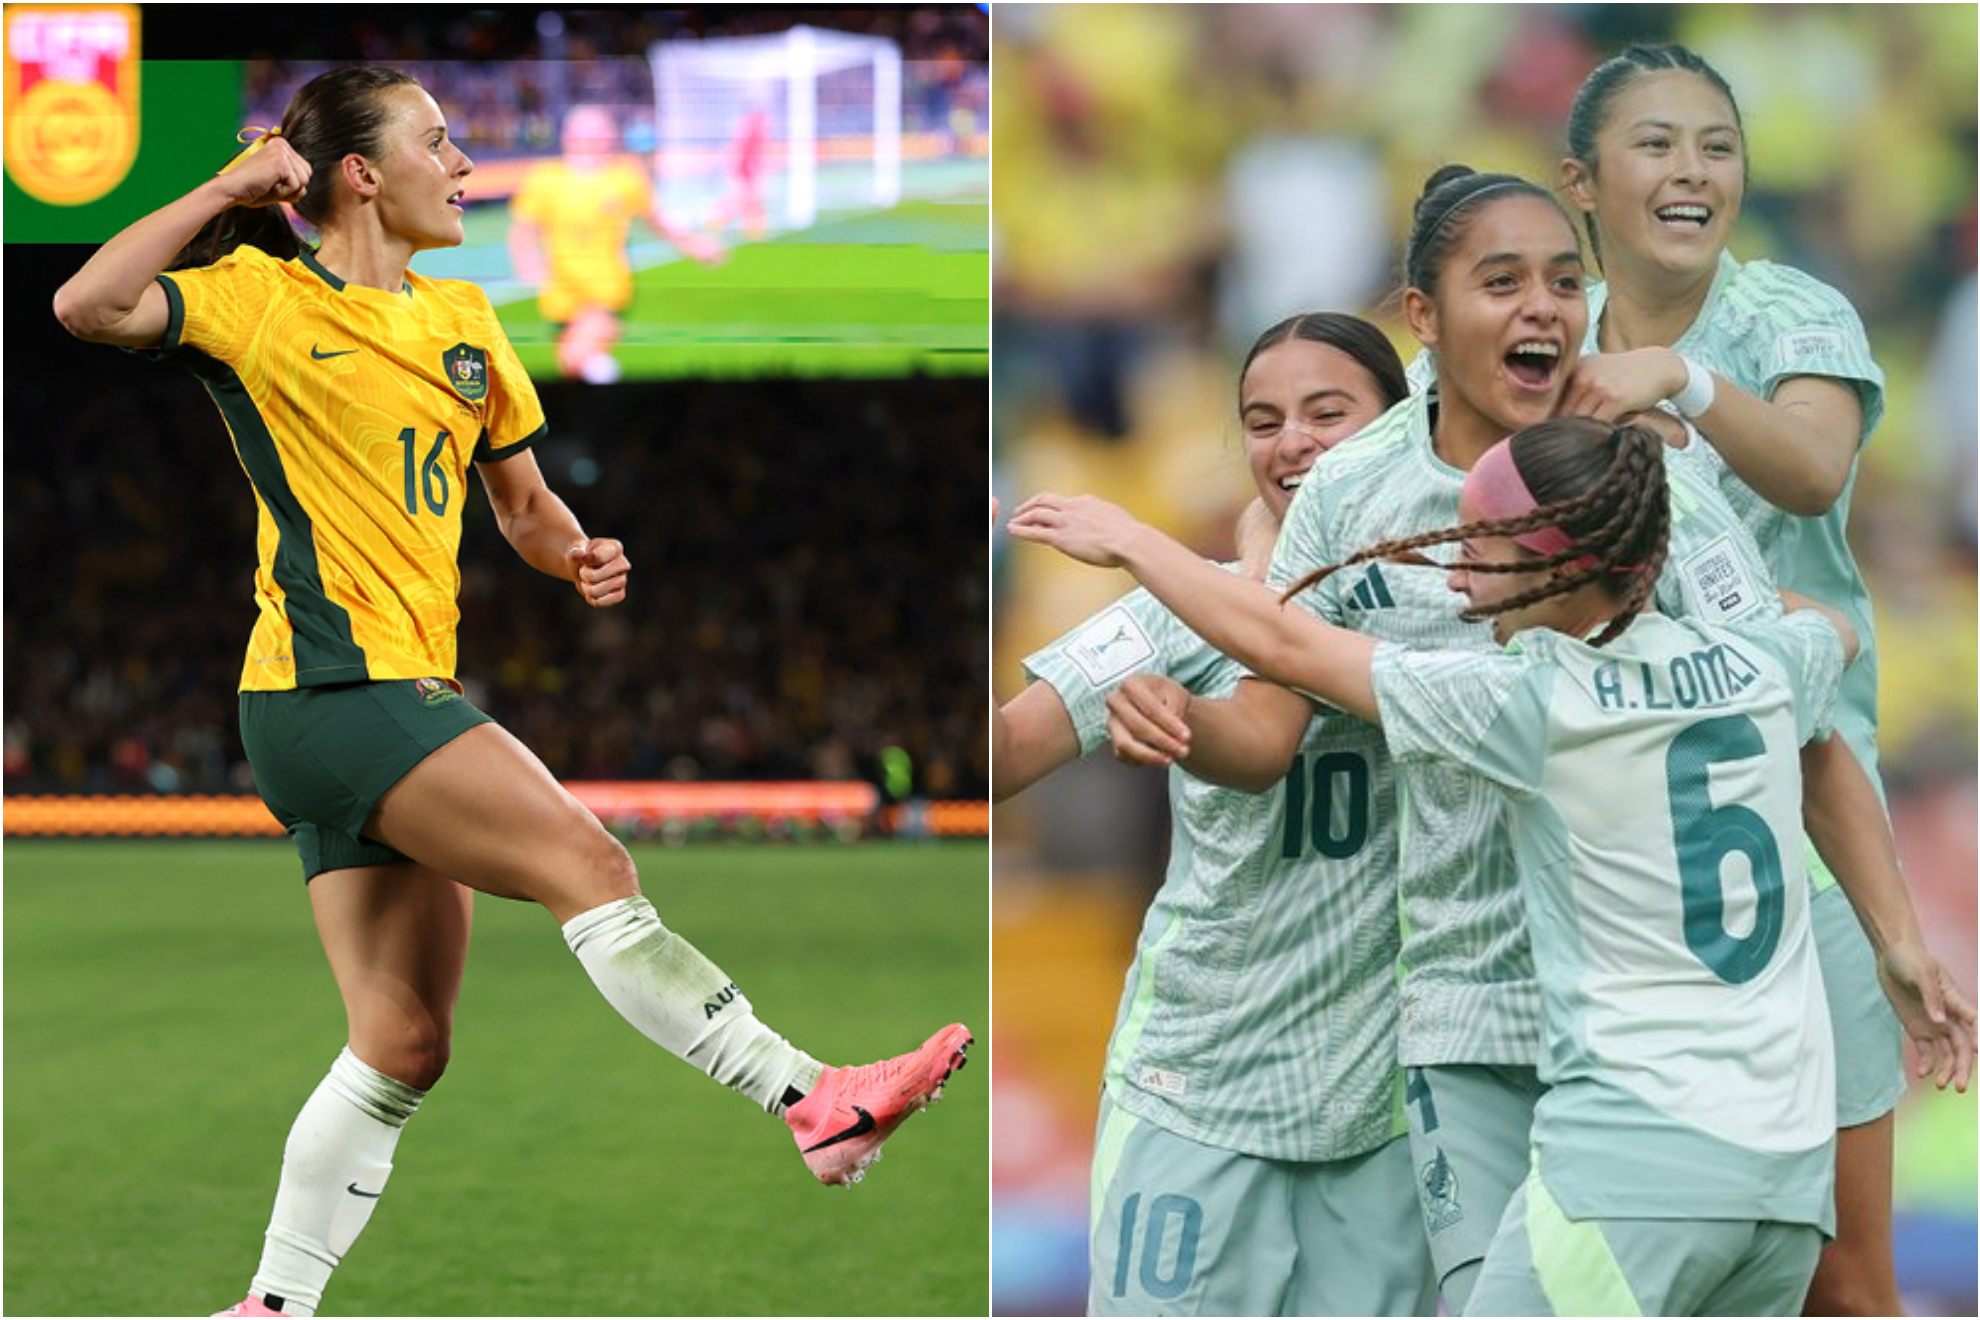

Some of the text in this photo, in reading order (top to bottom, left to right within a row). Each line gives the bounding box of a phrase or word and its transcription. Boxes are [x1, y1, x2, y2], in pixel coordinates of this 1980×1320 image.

[397, 427, 450, 518] 16
[1283, 752, 1370, 860] 10
[1666, 713, 1785, 985] 6
[1112, 1192, 1204, 1299] 10
